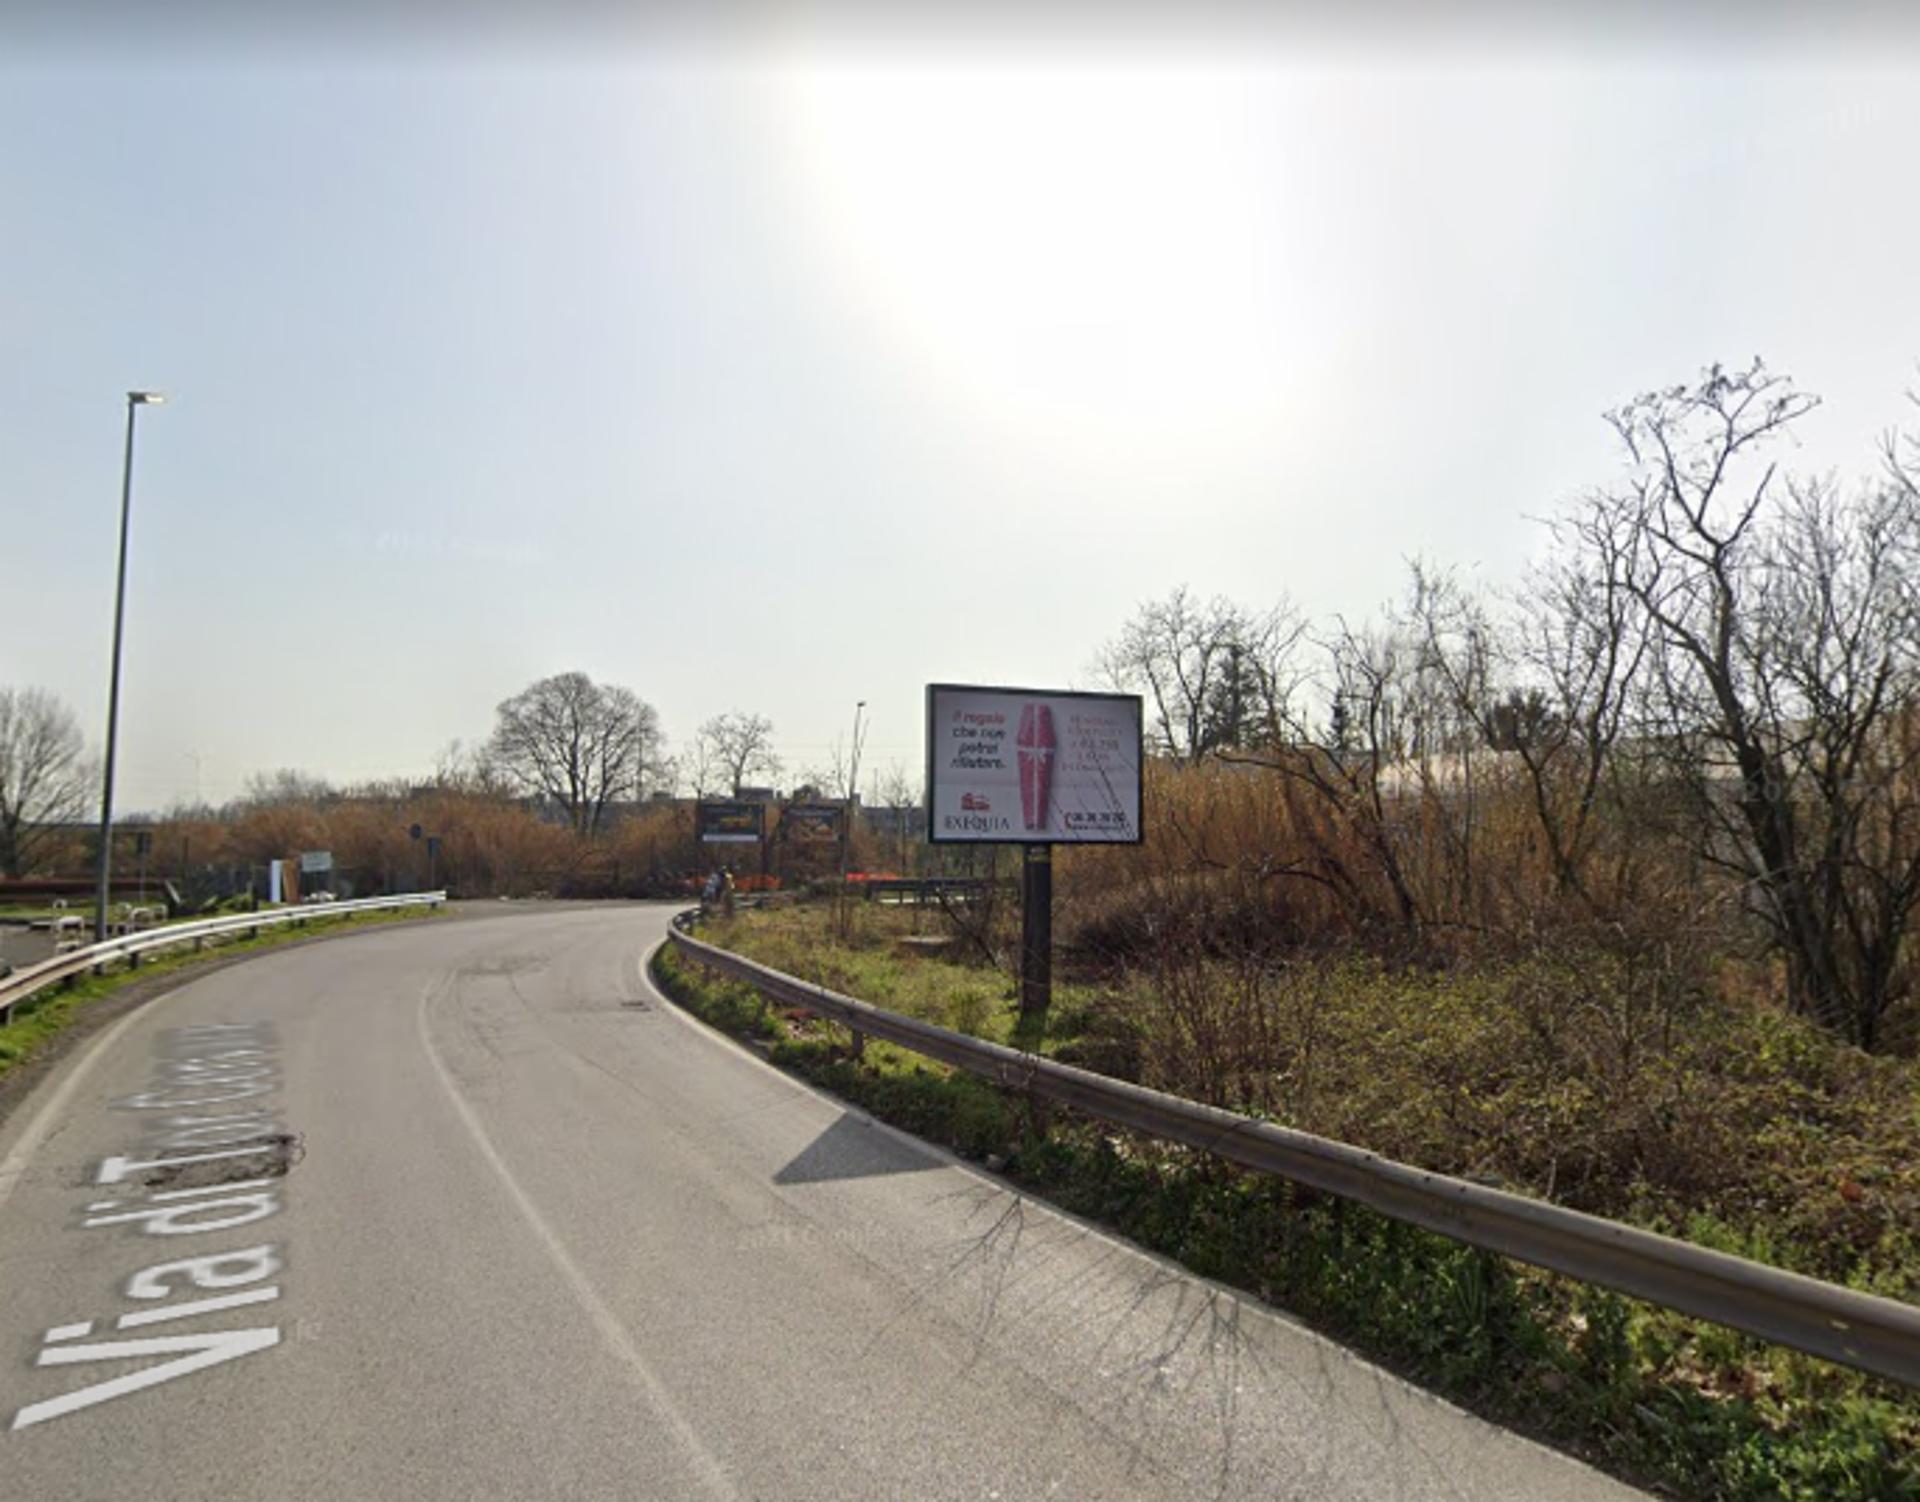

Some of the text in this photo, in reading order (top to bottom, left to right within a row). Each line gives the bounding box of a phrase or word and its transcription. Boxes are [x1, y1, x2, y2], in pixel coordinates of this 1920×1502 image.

[963, 711, 1005, 726] regalo
[952, 725, 977, 737] che
[958, 742, 998, 757] potrai
[944, 815, 1010, 832] EXEQUIA
